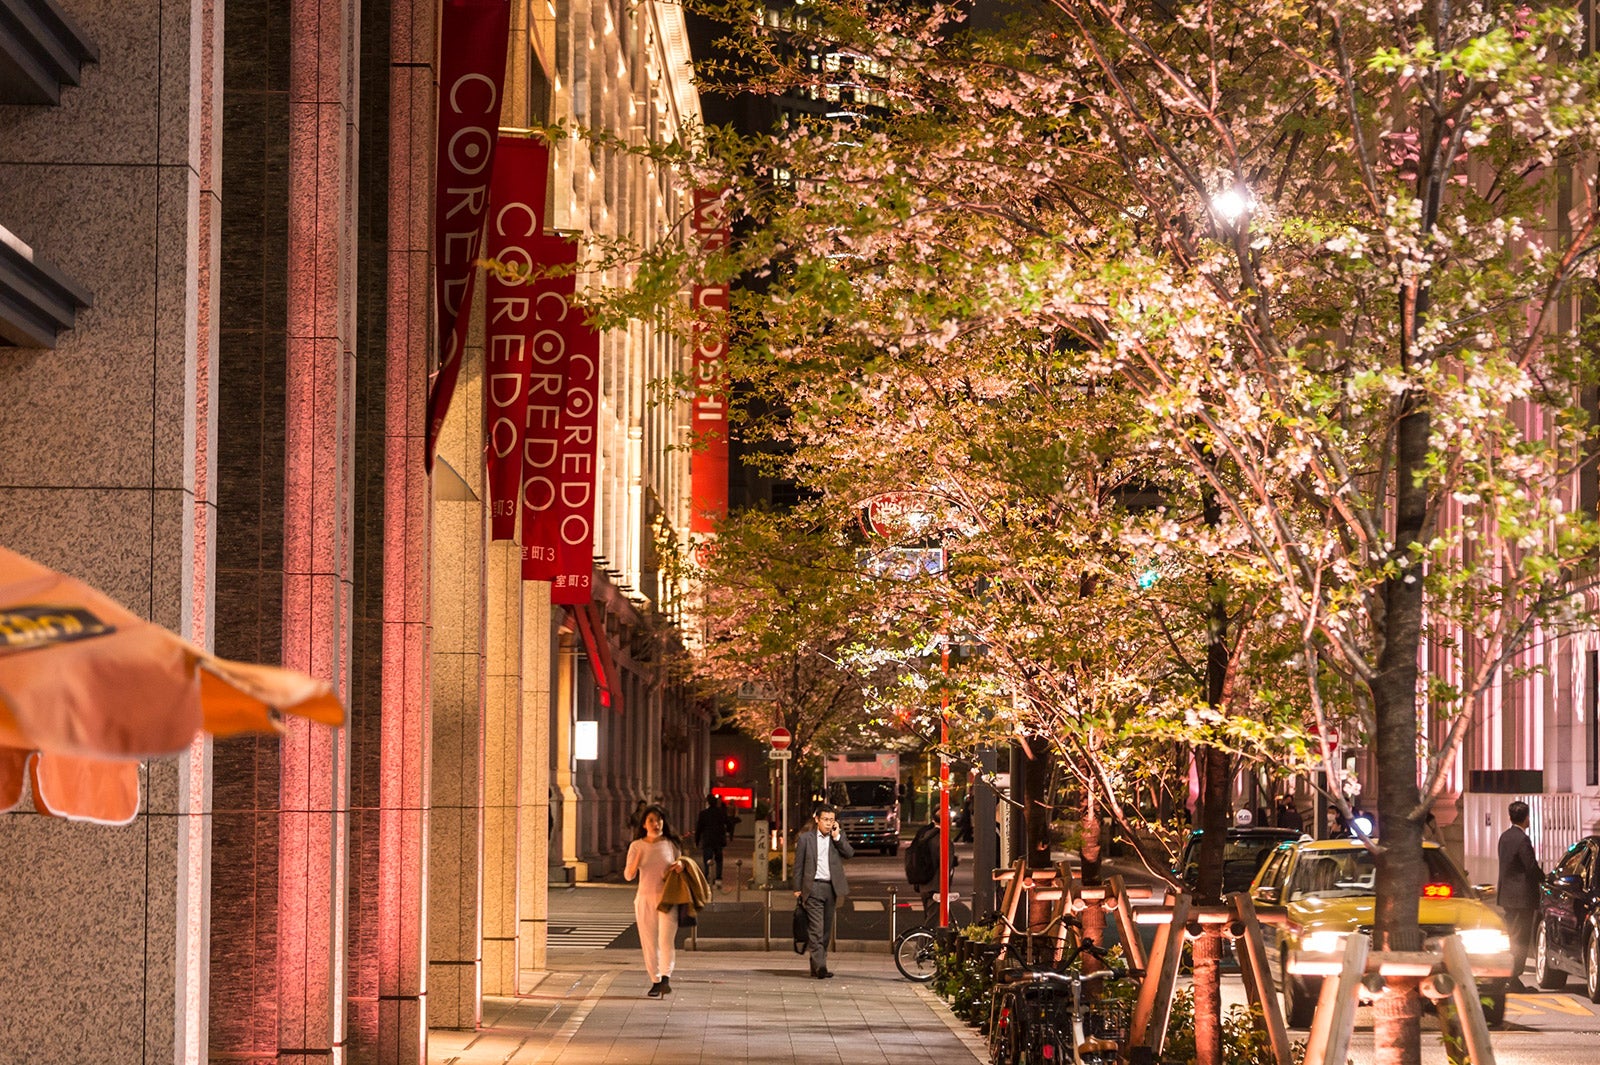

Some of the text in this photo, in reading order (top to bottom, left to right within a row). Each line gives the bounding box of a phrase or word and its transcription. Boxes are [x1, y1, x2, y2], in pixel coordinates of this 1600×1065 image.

[490, 202, 536, 459] COREDO
[523, 291, 567, 512] COREDO
[698, 198, 723, 420] MIUOSHI
[560, 354, 594, 545] COREDO
[521, 545, 555, 562] 室町3
[555, 575, 589, 588] 室町3
